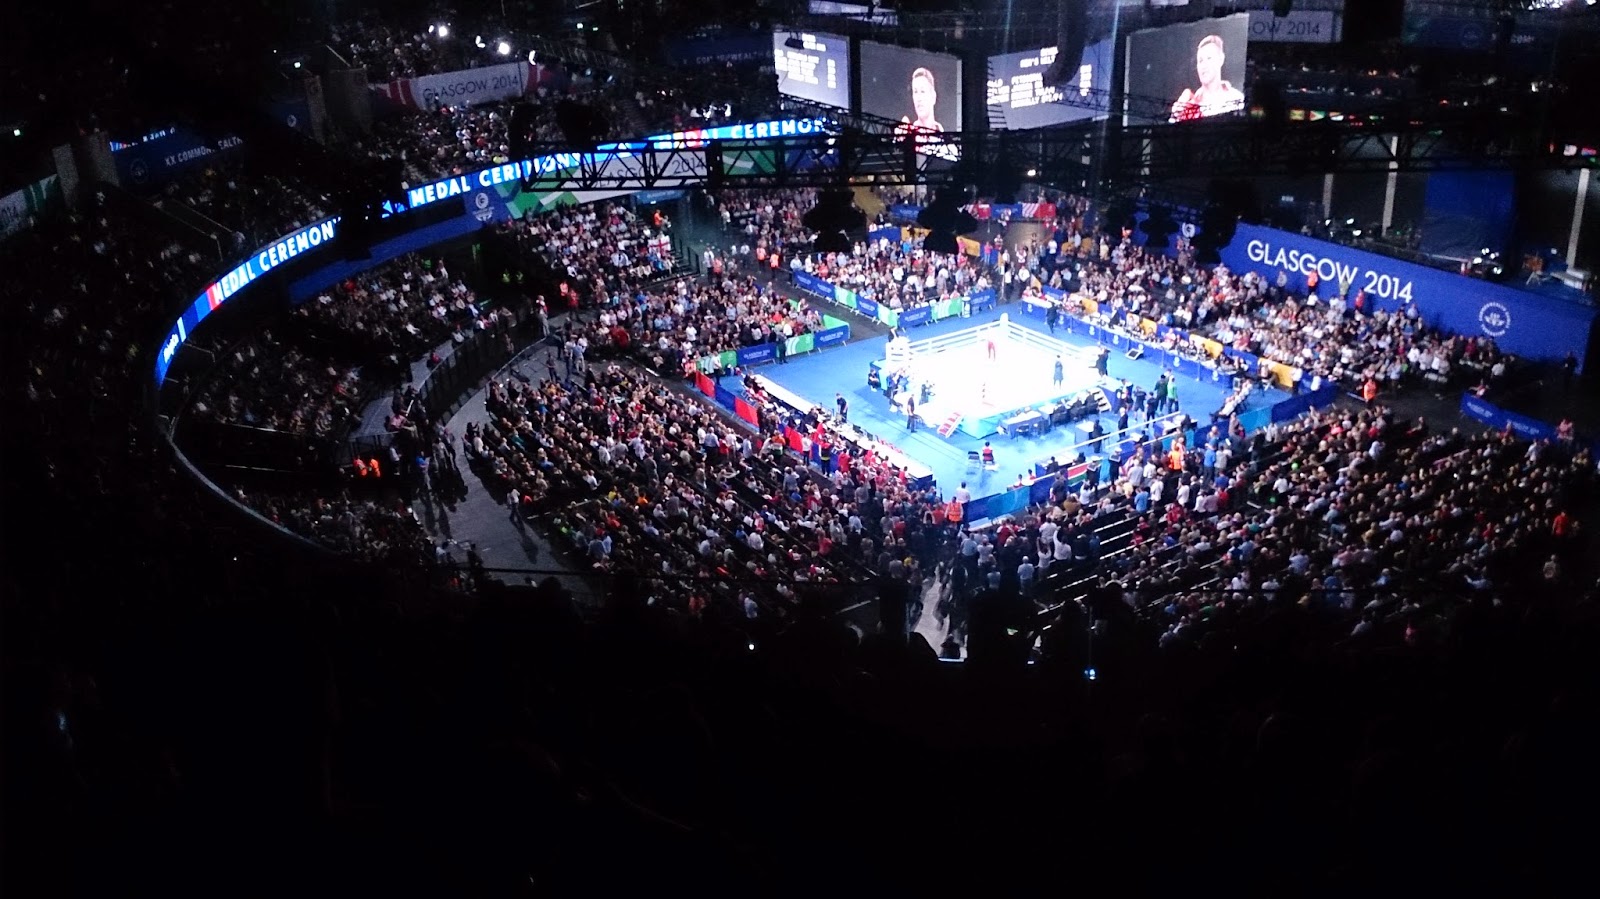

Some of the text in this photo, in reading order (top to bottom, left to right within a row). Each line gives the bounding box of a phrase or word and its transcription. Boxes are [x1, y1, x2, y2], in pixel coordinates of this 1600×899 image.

[1287, 21, 1320, 35] 2014
[422, 75, 519, 100] GLASGOW 2014
[730, 117, 828, 141] CEREMON
[408, 175, 471, 208] MEDAL
[213, 216, 342, 305] MEDAL CEREMON
[1247, 240, 1413, 303] GLASGOW 2014
